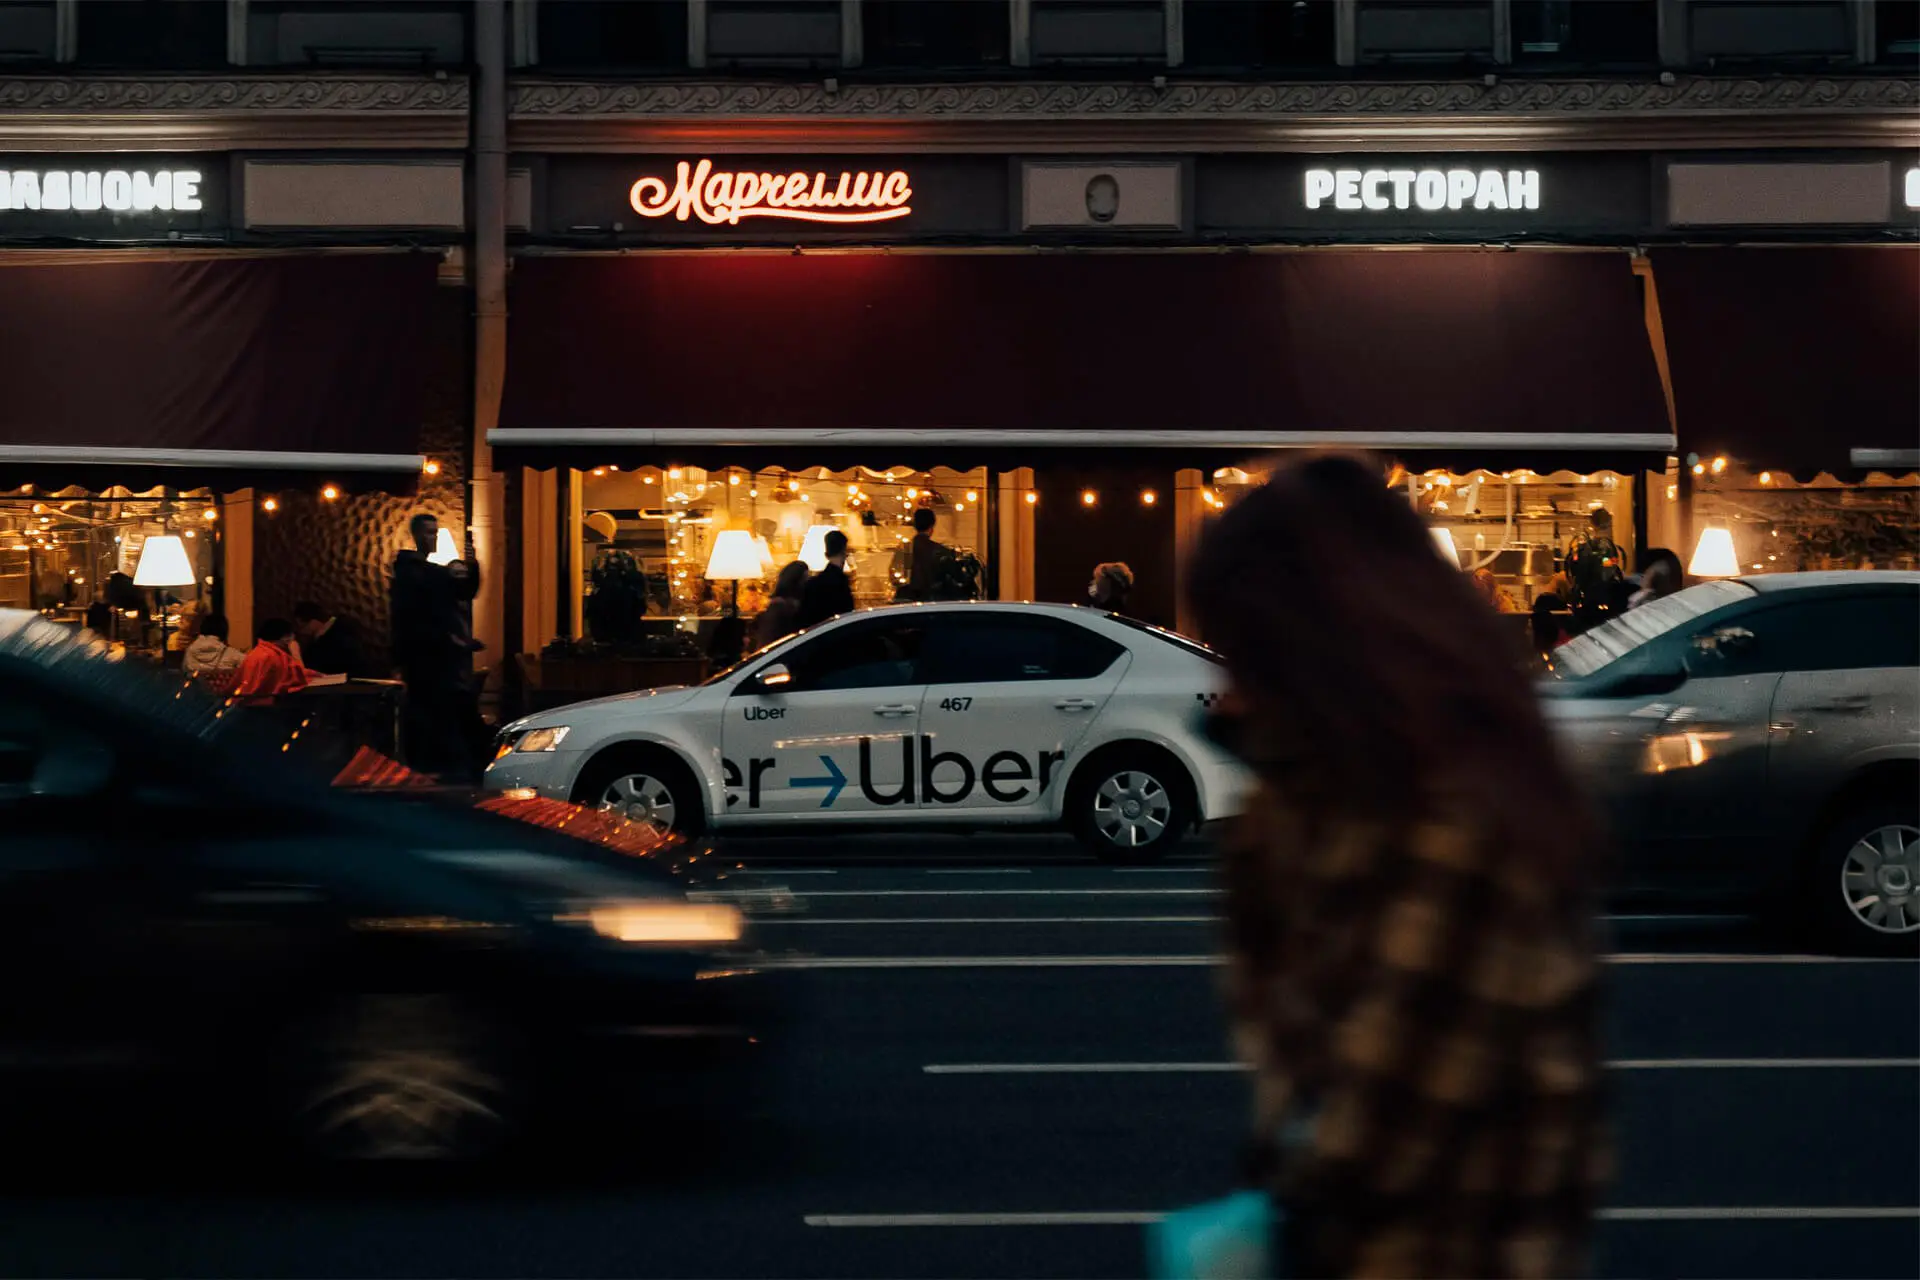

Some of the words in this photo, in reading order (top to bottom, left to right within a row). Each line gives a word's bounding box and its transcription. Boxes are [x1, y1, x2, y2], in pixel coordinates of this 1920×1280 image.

[630, 159, 912, 225] Марчеллис
[1304, 169, 1540, 210] РЕСТОРАН
[743, 706, 786, 721] Uber
[939, 697, 973, 712] 467
[859, 735, 1064, 806] Uber
